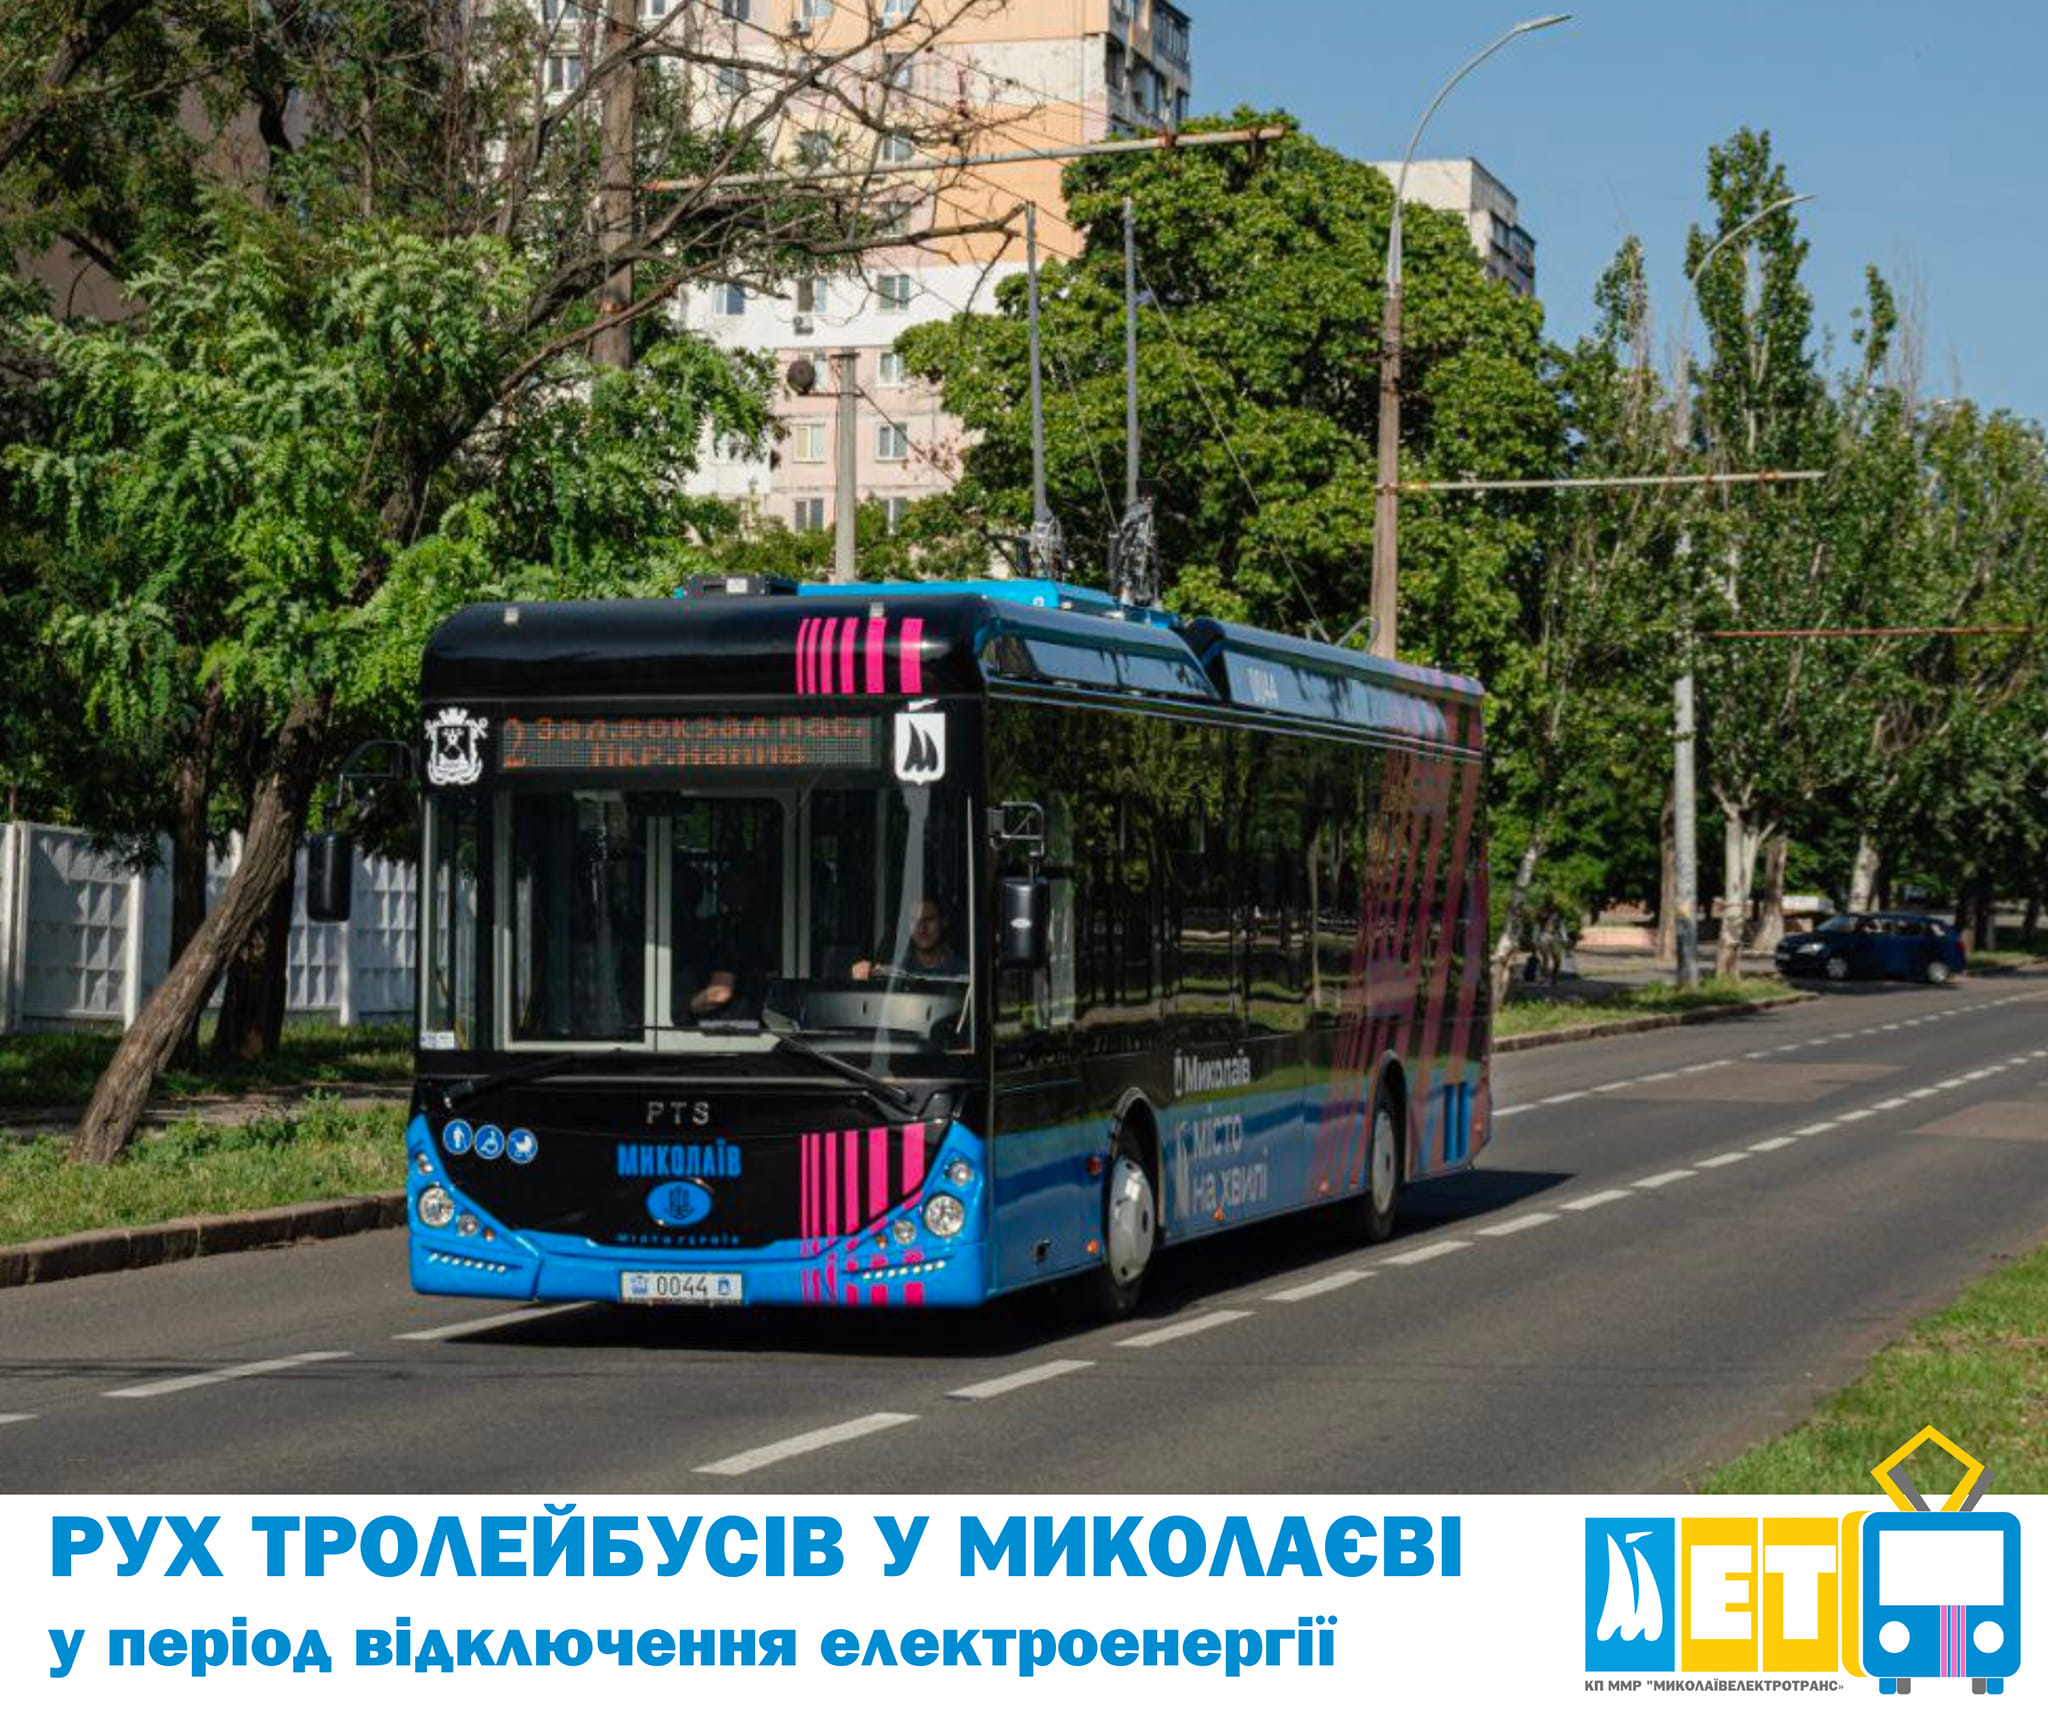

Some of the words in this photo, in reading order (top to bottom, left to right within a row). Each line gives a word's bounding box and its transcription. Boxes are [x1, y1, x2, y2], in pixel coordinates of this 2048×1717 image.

[503, 718, 525, 767] 2
[1184, 1048, 1250, 1093] Миколаїв
[646, 1101, 709, 1125] PTS
[617, 1138, 742, 1176] МИКОЛАЇВ
[656, 1275, 708, 1296] 0044
